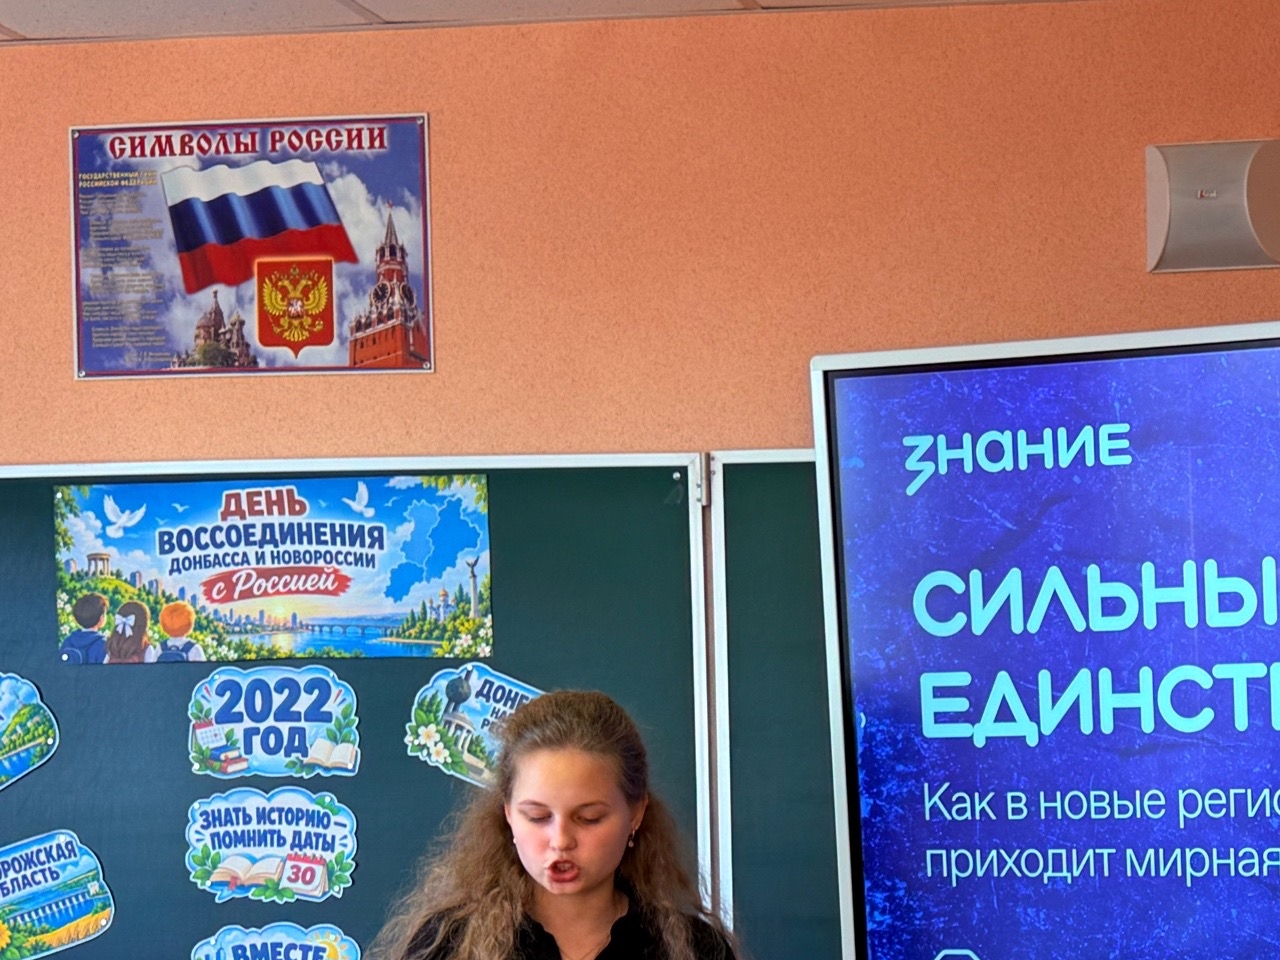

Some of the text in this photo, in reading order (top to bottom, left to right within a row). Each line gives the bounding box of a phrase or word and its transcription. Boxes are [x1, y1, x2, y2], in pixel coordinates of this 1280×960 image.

[109, 126, 388, 159] СИМВОЛЫ РОССИИ
[220, 488, 307, 521] ДЕНЬ
[157, 522, 384, 555] ВОССОЕДИНЕНИЯ
[168, 550, 376, 576] ДОНБАССА И НОВОРОССИИ
[211, 567, 340, 600] с Россией
[913, 555, 1279, 637] СИЛЬНЫ
[214, 676, 333, 725] 2022
[243, 726, 309, 758] ГОД
[200, 806, 252, 831] ЗНАТЬ
[256, 806, 331, 830] ИСТОРИЮ
[923, 783, 996, 821] Как
[1007, 790, 1027, 820] в
[1040, 788, 1166, 820] новые
[210, 829, 336, 853] ПОМНИТЬ ДАТЫ
[287, 864, 316, 884] 30
[925, 847, 1115, 886] приходит
